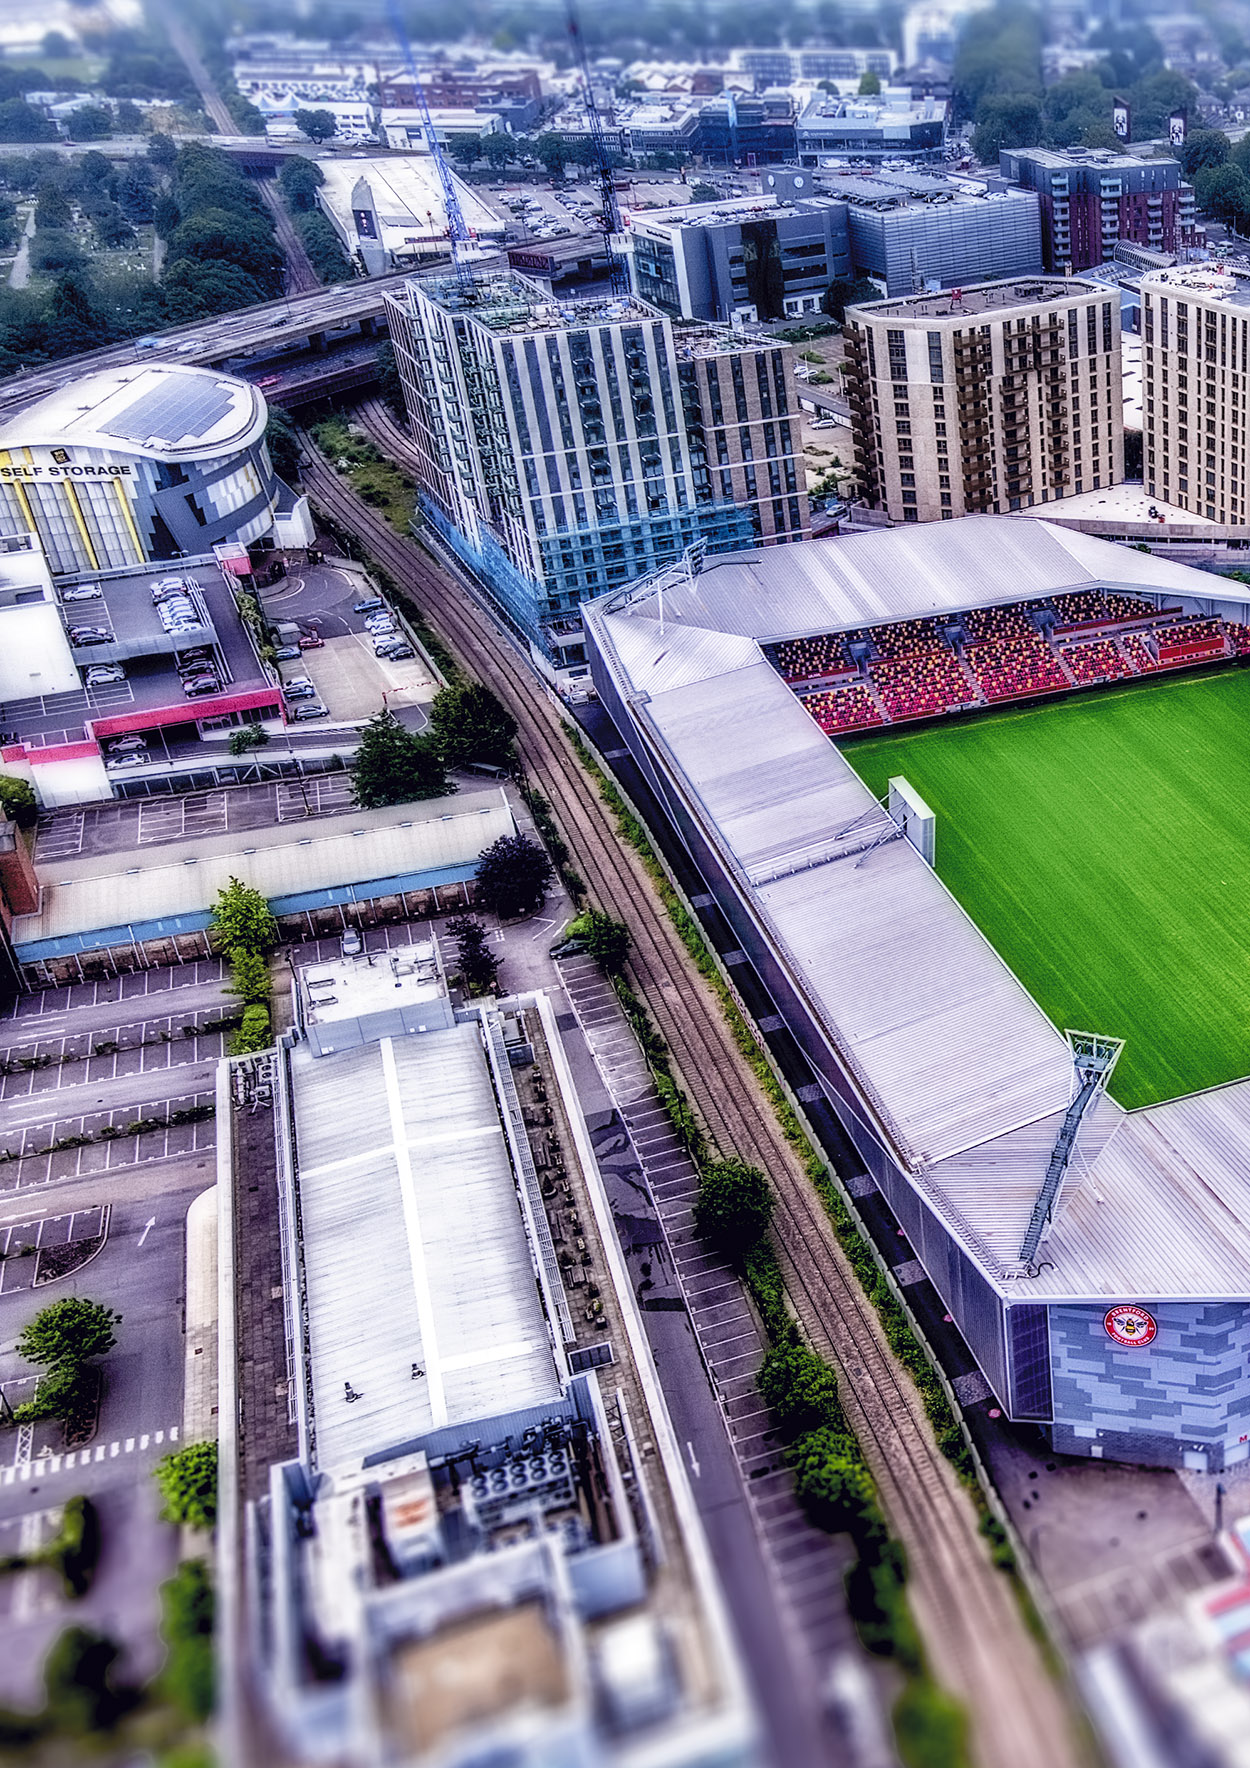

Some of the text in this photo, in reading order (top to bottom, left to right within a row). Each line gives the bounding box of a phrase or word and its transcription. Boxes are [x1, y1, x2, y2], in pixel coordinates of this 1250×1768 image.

[0, 466, 131, 477] SELF STORAGE
[1111, 1308, 1149, 1320] BRENTFORD
[1111, 1332, 1150, 1345] FOOTBALL CLUB
[1239, 1435, 1248, 1443] M
